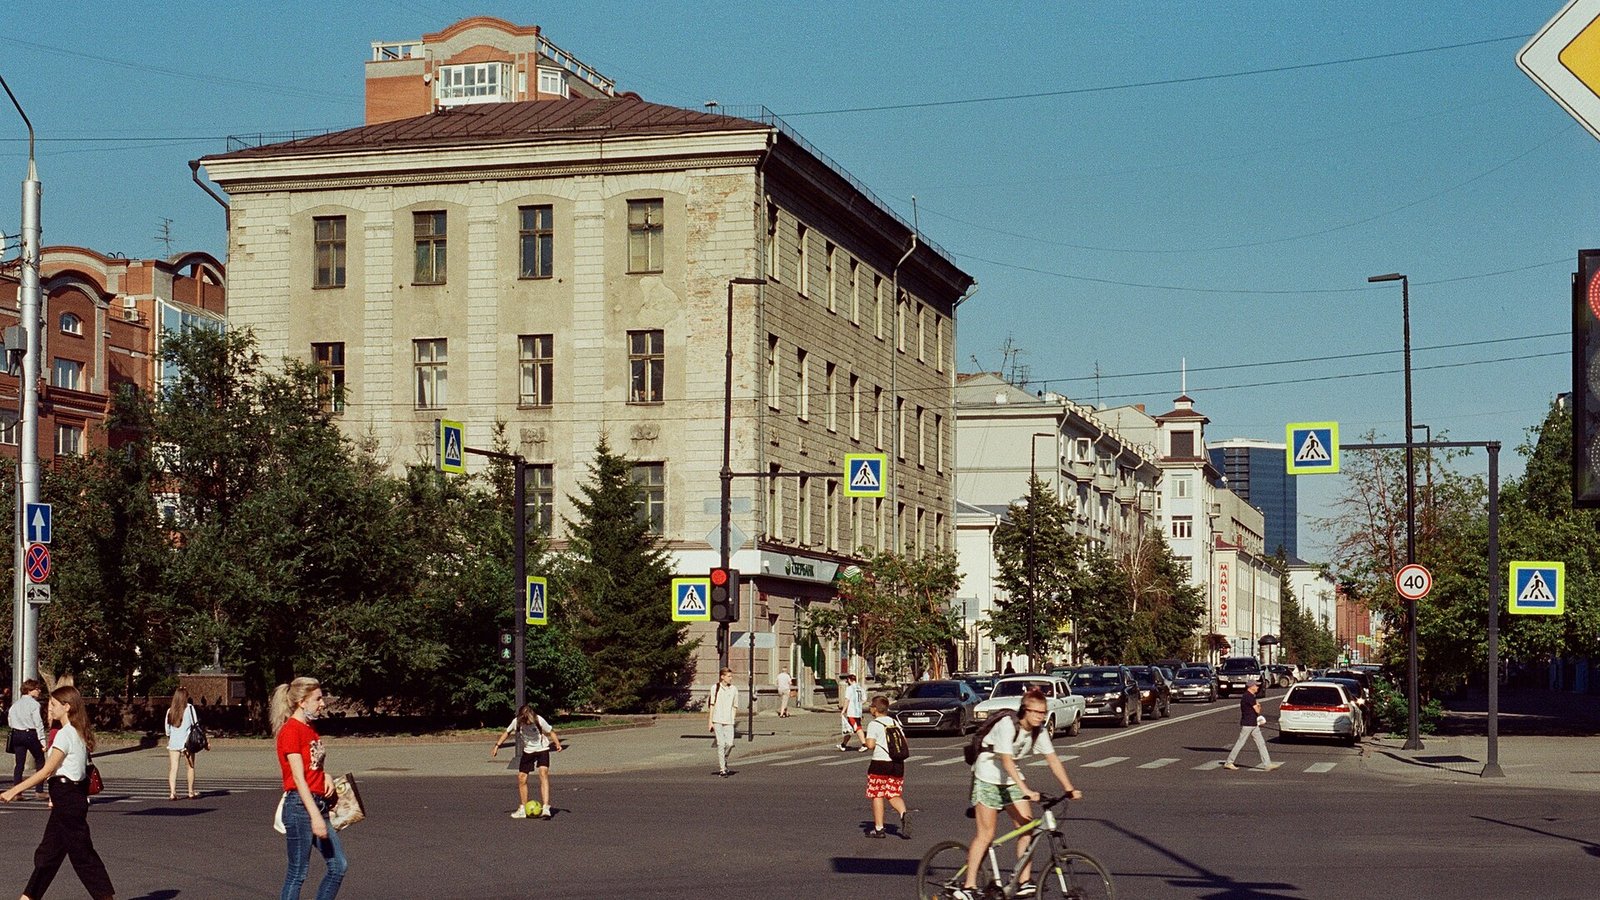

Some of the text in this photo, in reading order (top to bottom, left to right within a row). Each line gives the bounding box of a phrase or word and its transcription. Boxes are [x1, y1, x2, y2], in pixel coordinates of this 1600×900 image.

[1220, 564, 1228, 625] MAMA ROMA
[1403, 575, 1425, 589] 40
